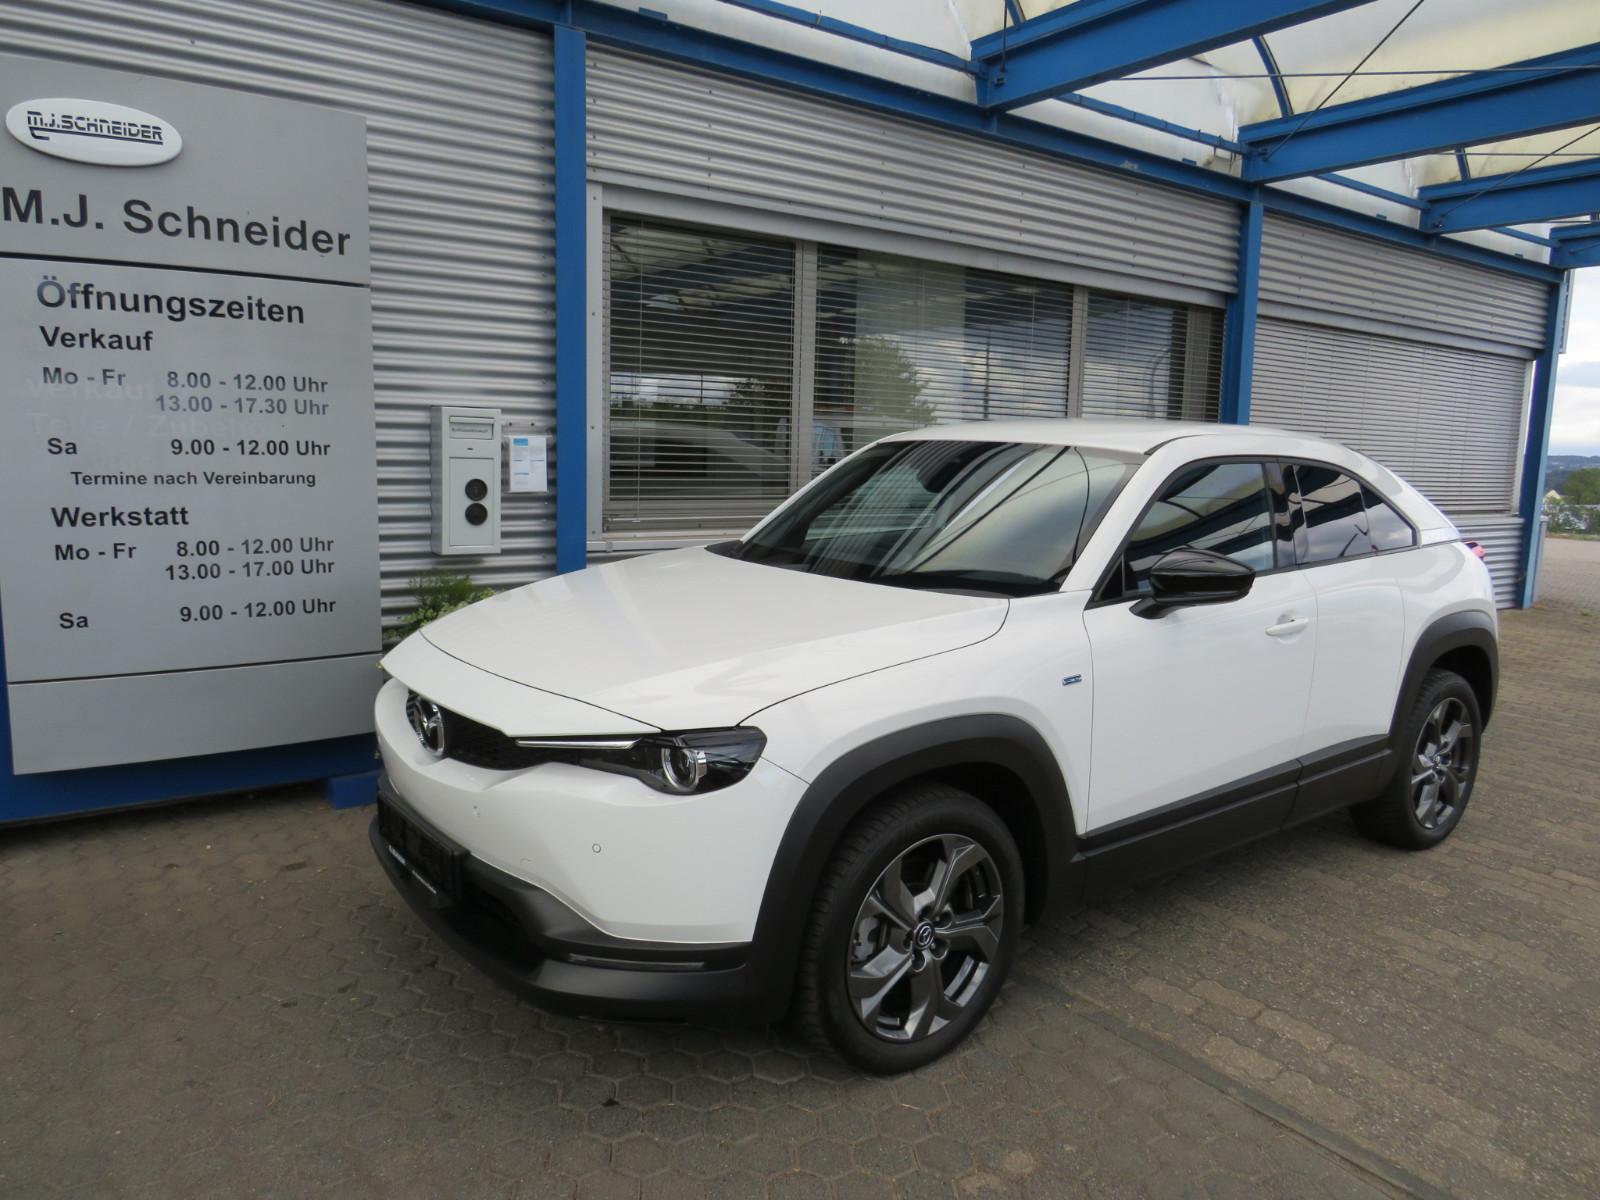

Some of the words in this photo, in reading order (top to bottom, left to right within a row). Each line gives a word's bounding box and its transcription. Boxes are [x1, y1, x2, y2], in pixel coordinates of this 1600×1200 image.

[2, 186, 104, 230] M.J.
[123, 199, 351, 255] Schneider
[37, 275, 305, 324] Öffnungszeiten
[39, 325, 154, 351] Verkauf
[42, 367, 78, 384] Mo
[102, 368, 126, 386] Fr
[167, 371, 211, 388] 8.00
[233, 374, 286, 391] 12.00
[293, 376, 328, 392] Uhr
[156, 395, 212, 412] 13.00
[235, 398, 287, 414] 17.30
[295, 399, 329, 415] Uhr
[48, 438, 78, 455] Sa
[171, 439, 215, 455] 9.00
[237, 440, 289, 456] 12.00
[296, 440, 331, 456] Uhr
[70, 472, 147, 485] Termine
[154, 472, 197, 485] nach
[203, 472, 316, 487] Vereinbarung
[50, 506, 189, 528] Werkstatt
[55, 544, 90, 560] Mo
[113, 543, 136, 559] Fr
[177, 540, 220, 557] 8.00
[241, 538, 293, 555] 12.00
[300, 537, 334, 552] Uhr
[165, 563, 221, 580] 13.00
[242, 560, 294, 577] 17.00
[301, 559, 335, 574] Uhr
[180, 605, 223, 622] 9.00
[244, 600, 295, 618] 12.00
[303, 598, 336, 614] Uhr
[59, 612, 88, 629] Sa
